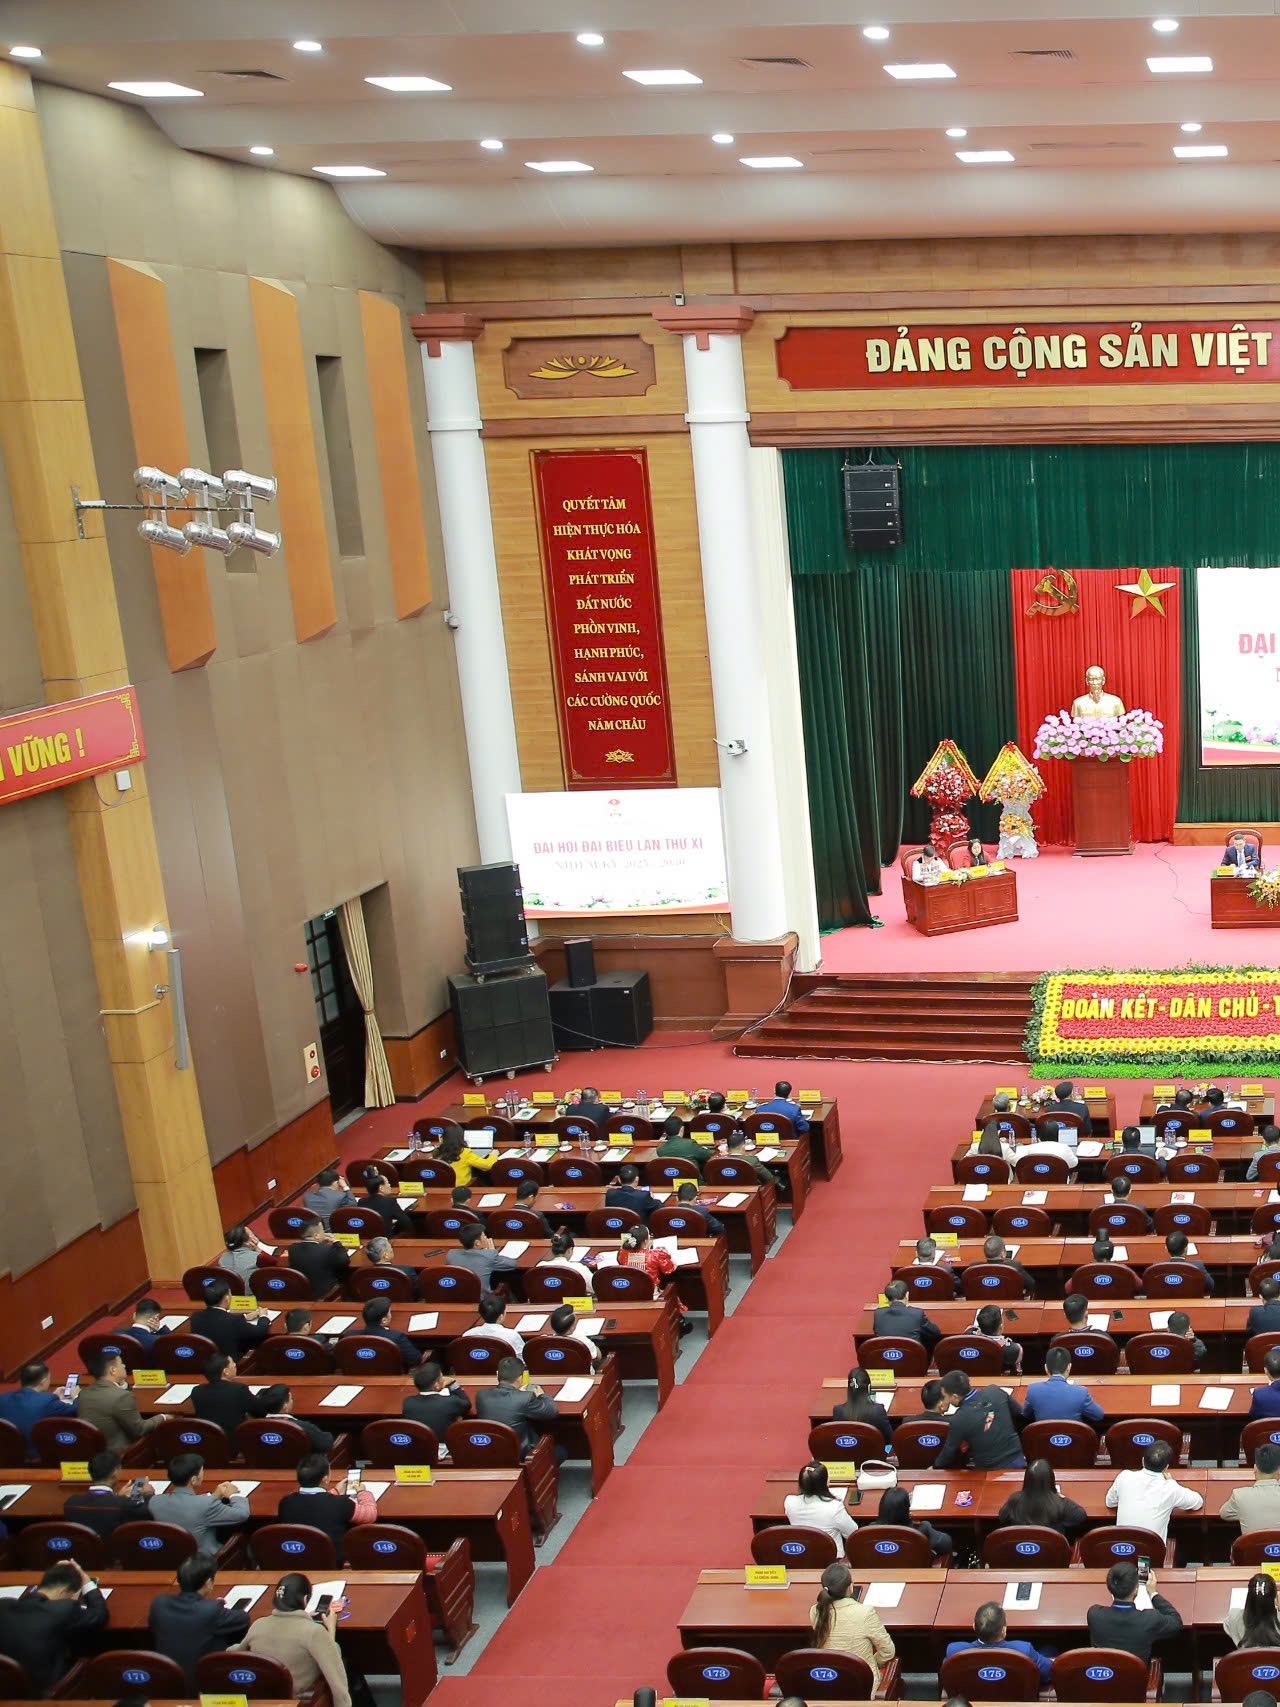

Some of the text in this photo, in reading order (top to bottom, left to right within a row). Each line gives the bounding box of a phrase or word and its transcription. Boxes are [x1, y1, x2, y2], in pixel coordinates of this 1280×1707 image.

[865, 326, 972, 374] ĐẢNG
[982, 327, 1087, 378] CỘNG
[1099, 321, 1178, 370] SẢN
[1189, 323, 1273, 375] VIỆT
[563, 495, 626, 512] QUYẾT TÂM
[553, 522, 641, 537] HIỆN THỰC HÓA
[567, 547, 631, 561] KHÁT VỌNG
[569, 569, 634, 584] PHÁT TRIỂN
[577, 595, 632, 609] ĐẤT NƯỚC
[574, 619, 639, 634] PHỒN VINH,
[574, 645, 643, 660] HẠNH PHÚC,
[1239, 633, 1275, 658] ĐẠI
[575, 669, 648, 682] SÁNH VAI VỚI
[567, 692, 661, 707] CÁC CƯỜNG QUỐC
[588, 717, 646, 730] NĂM CHÂU
[7, 732, 71, 777] VỮNG
[1061, 992, 1114, 1019] ĐOÀN
[1170, 992, 1211, 1017] DÂN
[1218, 989, 1259, 1017] CHỦ
